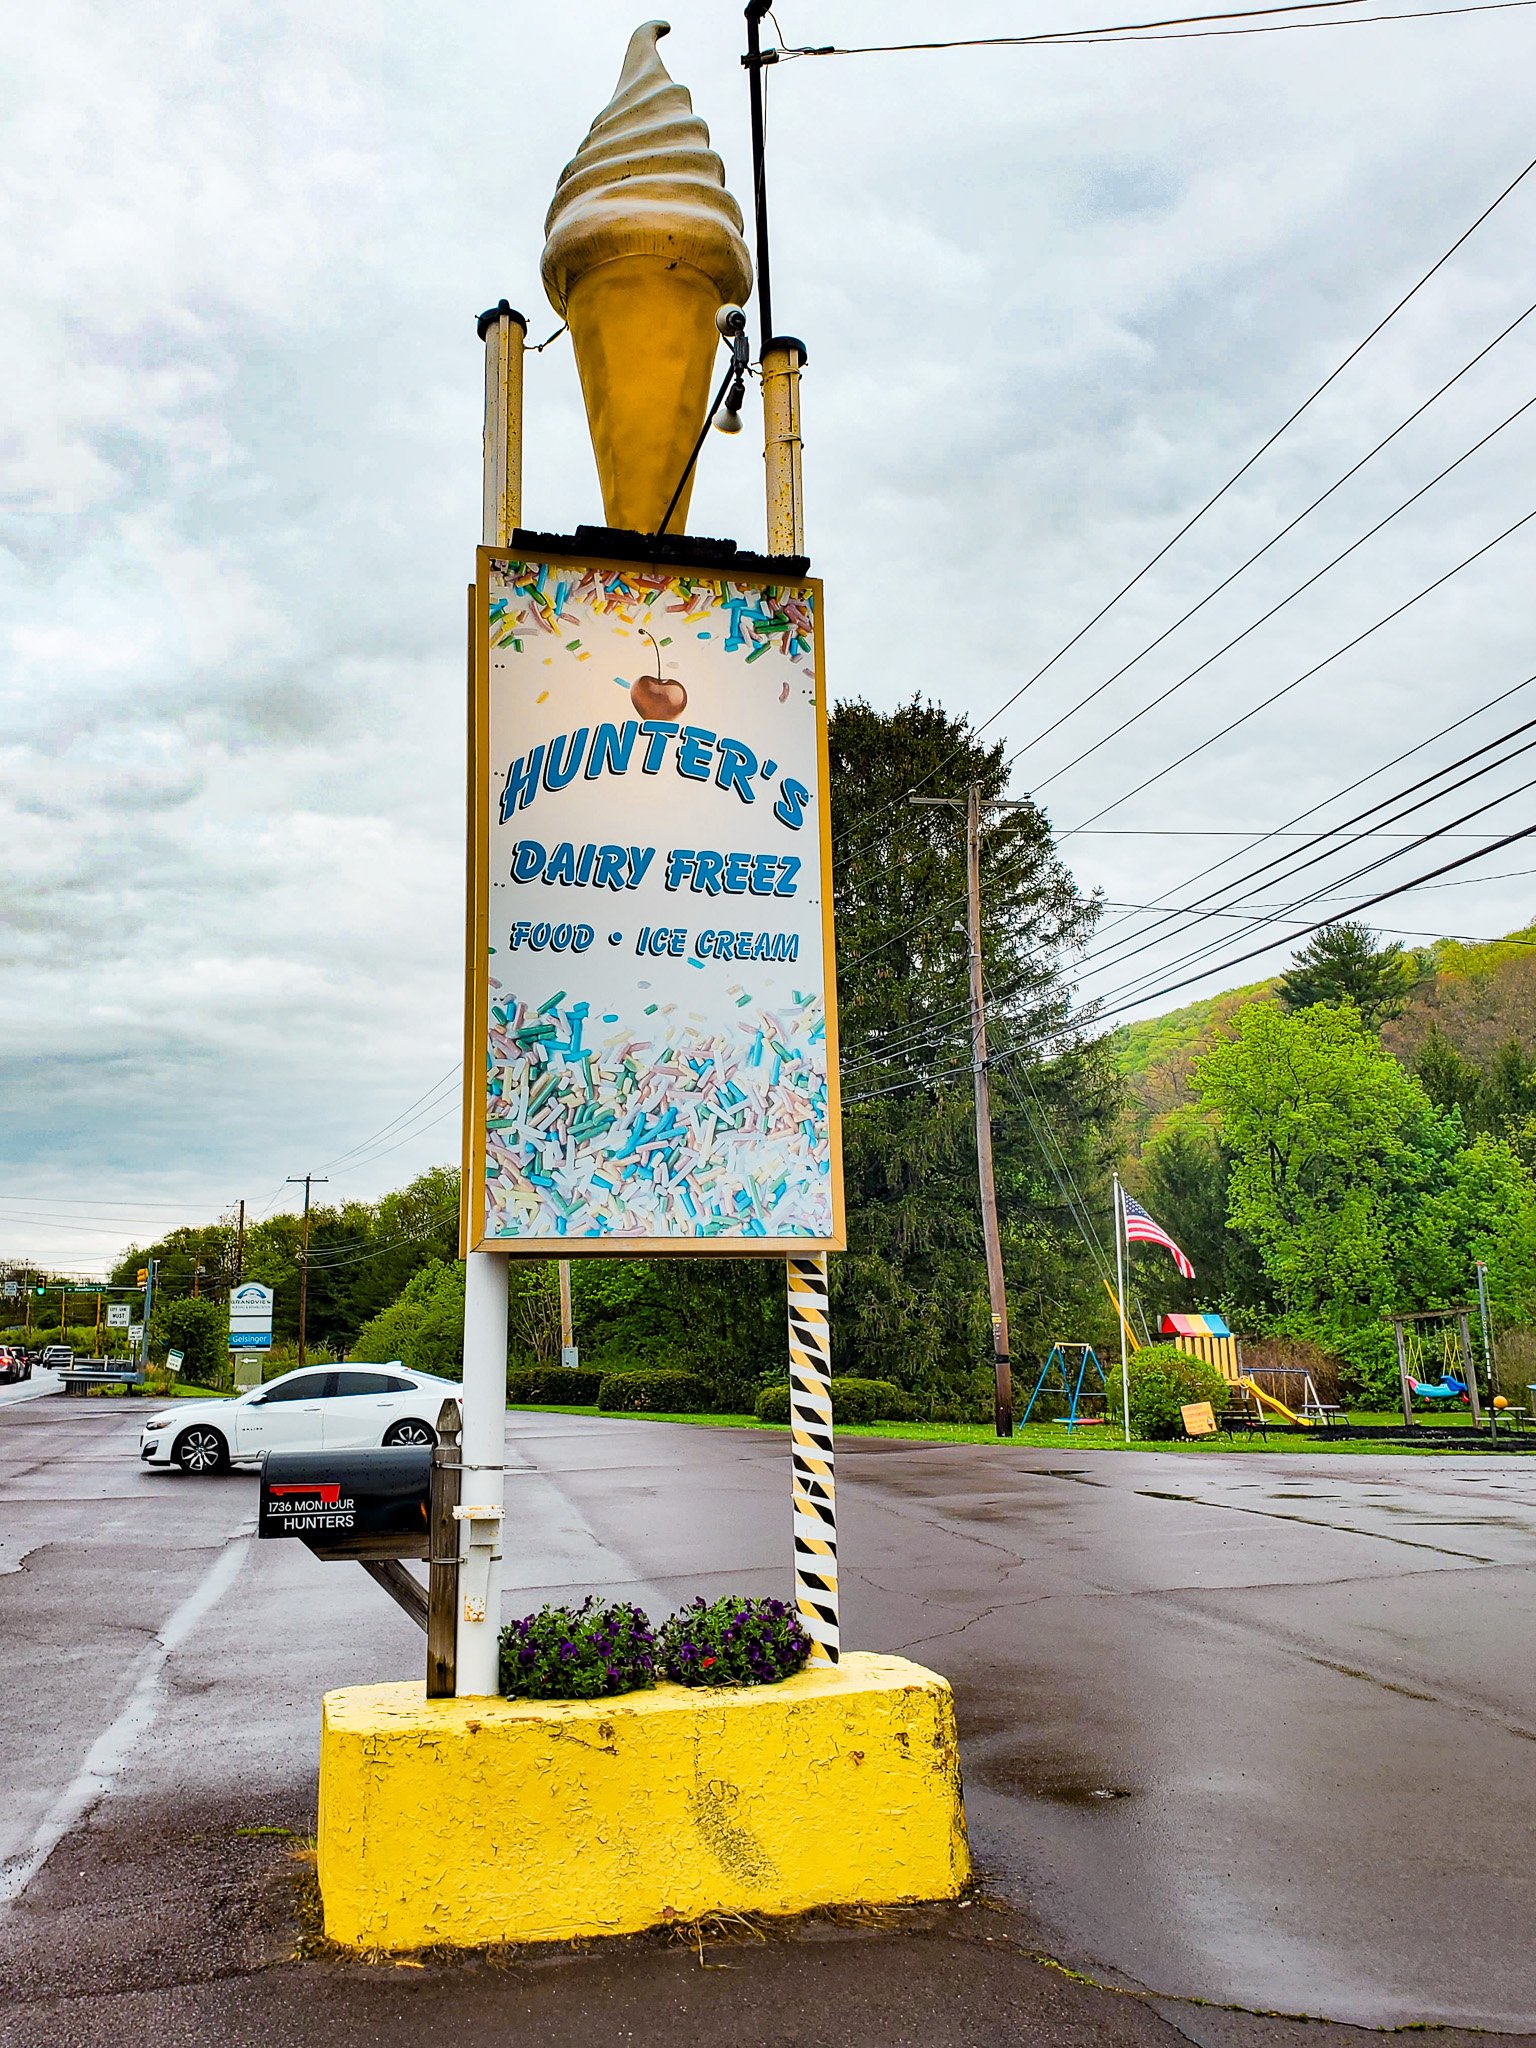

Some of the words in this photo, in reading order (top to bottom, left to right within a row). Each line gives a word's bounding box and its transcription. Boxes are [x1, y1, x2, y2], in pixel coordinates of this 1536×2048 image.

[498, 720, 810, 831] HUNTER'S
[510, 840, 656, 891] DAIRY
[665, 849, 802, 897] FREEZ
[509, 921, 595, 953] FOOD
[635, 927, 688, 957] ICE
[695, 929, 800, 962] CREAM
[232, 1335, 267, 1344] Geisinger
[269, 1502, 292, 1513] 1736
[295, 1499, 354, 1512] MONTOUR
[284, 1515, 354, 1530] HUNTERS
